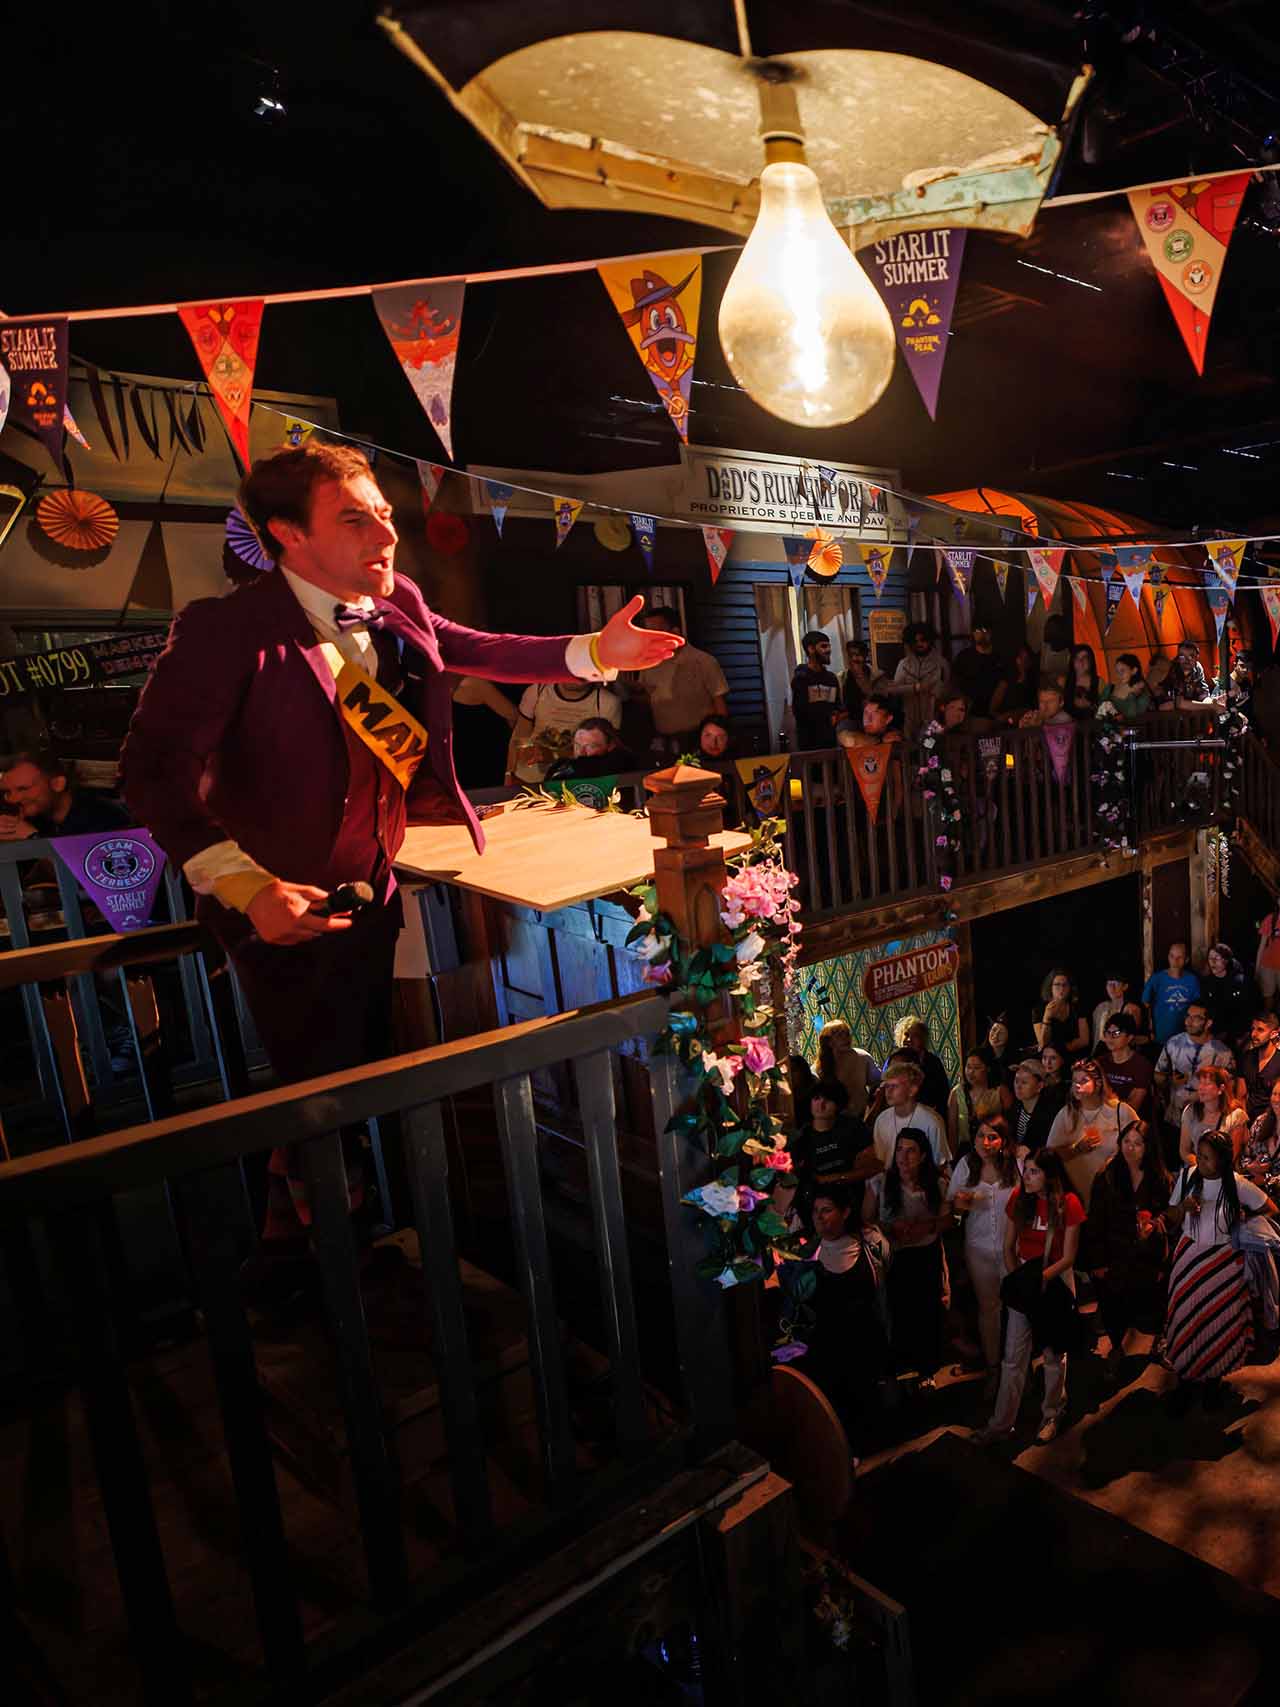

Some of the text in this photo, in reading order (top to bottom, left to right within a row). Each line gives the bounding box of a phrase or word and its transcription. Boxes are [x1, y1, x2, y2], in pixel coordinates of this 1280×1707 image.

[875, 229, 951, 265] STARLIT
[883, 258, 950, 287] SUMMER
[0, 327, 57, 352] STARLIT
[7, 351, 58, 371] SUMMER
[803, 477, 890, 514] EMPORIM
[690, 502, 776, 519] PROPRIETOR
[791, 510, 834, 523] DEBIE
[837, 515, 860, 525] AND
[864, 517, 885, 527] DAV
[948, 551, 973, 561] STARLIT
[26, 648, 91, 689] #0799
[343, 681, 423, 763] MAY
[101, 842, 135, 853] TEAM
[95, 866, 151, 888] TERRENCE
[106, 889, 147, 907] STARLIT
[872, 947, 951, 990] PHANTOM
